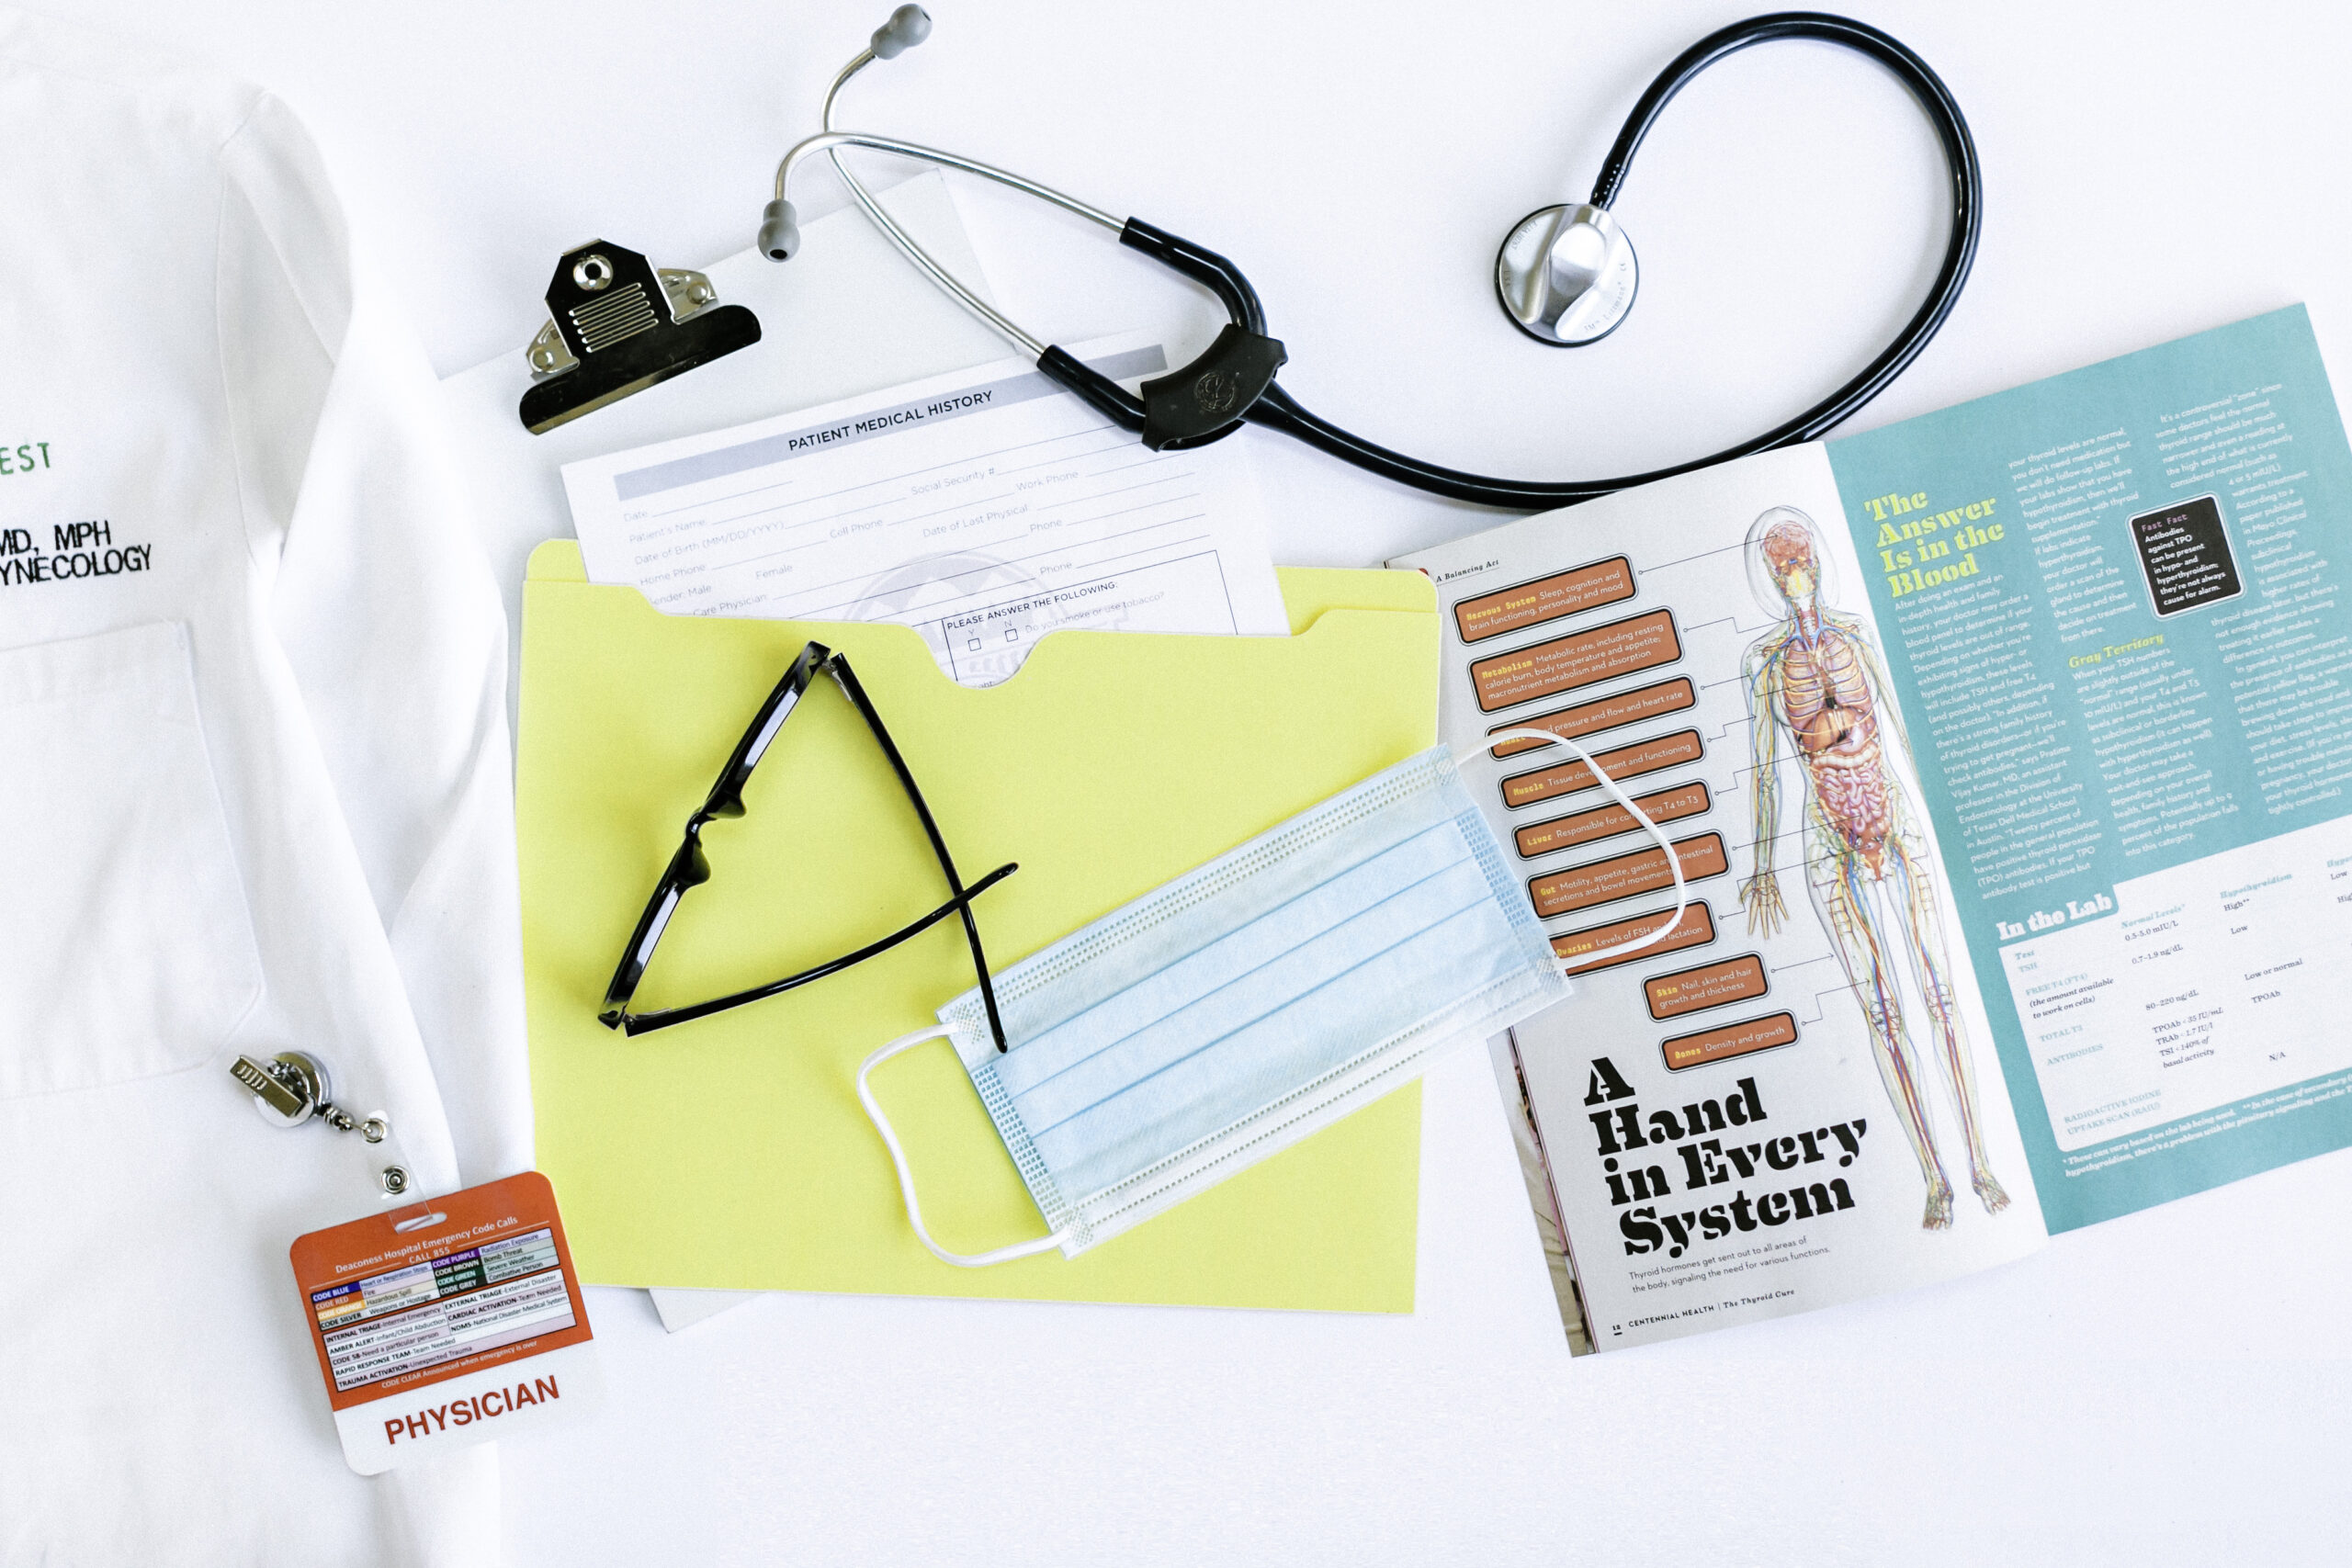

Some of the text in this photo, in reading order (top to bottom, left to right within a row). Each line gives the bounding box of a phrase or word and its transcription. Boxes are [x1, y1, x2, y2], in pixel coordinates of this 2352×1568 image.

[788, 389, 991, 450] PATIENT MEDICAL HISTORY
[910, 467, 994, 495] Social Security #
[1015, 469, 1079, 491] Work Phone
[1863, 491, 1928, 521] The
[54, 520, 111, 551] MPH
[829, 519, 883, 538] Cell Phone
[1876, 498, 1996, 547] Answer
[2141, 513, 2188, 532] Fast Fact
[2143, 525, 2185, 543] Antibodies
[1879, 524, 2004, 572] Is in the
[2145, 533, 2194, 555] against TPO
[2176, 543, 2205, 558] present
[639, 564, 706, 586] Home Phone
[755, 564, 792, 579] Female
[1444, 565, 1484, 581] Balancing
[1486, 558, 1499, 569] Act
[1887, 552, 1979, 597] Blood
[2155, 559, 2220, 586] hyperthyroidism;
[2161, 562, 2183, 571] hypo-
[2184, 555, 2199, 565] and
[687, 584, 711, 596] Male
[1465, 570, 1620, 620] Nervous System Sleep, cognition and
[2159, 571, 2226, 594] they're not always
[2163, 595, 2184, 605] cause
[2198, 585, 2221, 595] alarm.
[946, 581, 1117, 629] PLEASE ANSWER THE FOLLOWING:
[1468, 580, 1623, 631] brain functioning, personality and mood
[1481, 624, 1664, 679] Metabolism Metabolic rate, including resting
[1485, 637, 1661, 689] calorie burn, body temperature and appetite;
[2068, 634, 2163, 668] Gray Territory
[1487, 650, 1651, 700] macronutrient metabolism and absorption
[1996, 893, 2113, 941] In the Lab
[2244, 971, 2261, 980] Low
[2273, 957, 2302, 972] normal
[1674, 1025, 1784, 1060] Bones Density and growth
[1583, 1056, 1636, 1106] A
[1588, 1076, 1767, 1156] Hand
[1604, 1118, 1867, 1206] in Every
[1619, 1178, 1856, 1258] System
[334, 1215, 517, 1273] Deaconess Hospital Emergency Code Calls
[409, 1246, 449, 1263] CALL 855
[431, 1249, 476, 1269] CODE PURPLE
[1628, 1266, 1659, 1280] Thyroid
[1660, 1260, 1701, 1273] hormones
[1702, 1257, 1715, 1267] get
[1717, 1252, 1735, 1261] sent
[1736, 1249, 1750, 1258] out
[1763, 1243, 1772, 1252] all
[1774, 1240, 1796, 1249] areas
[1798, 1235, 1806, 1245] of
[434, 1258, 480, 1278] CODE BROWN
[1632, 1247, 1830, 1292] the body, signaling the need for various functions.
[311, 1284, 350, 1302] CODE BLUE
[320, 1312, 361, 1329] CODE SILVER
[1628, 1313, 1679, 1326] CENTENNIAL
[1681, 1304, 1713, 1316] HEALTH
[1740, 1292, 1772, 1304] Thyroid
[384, 1374, 560, 1445] PHYSICIAN
